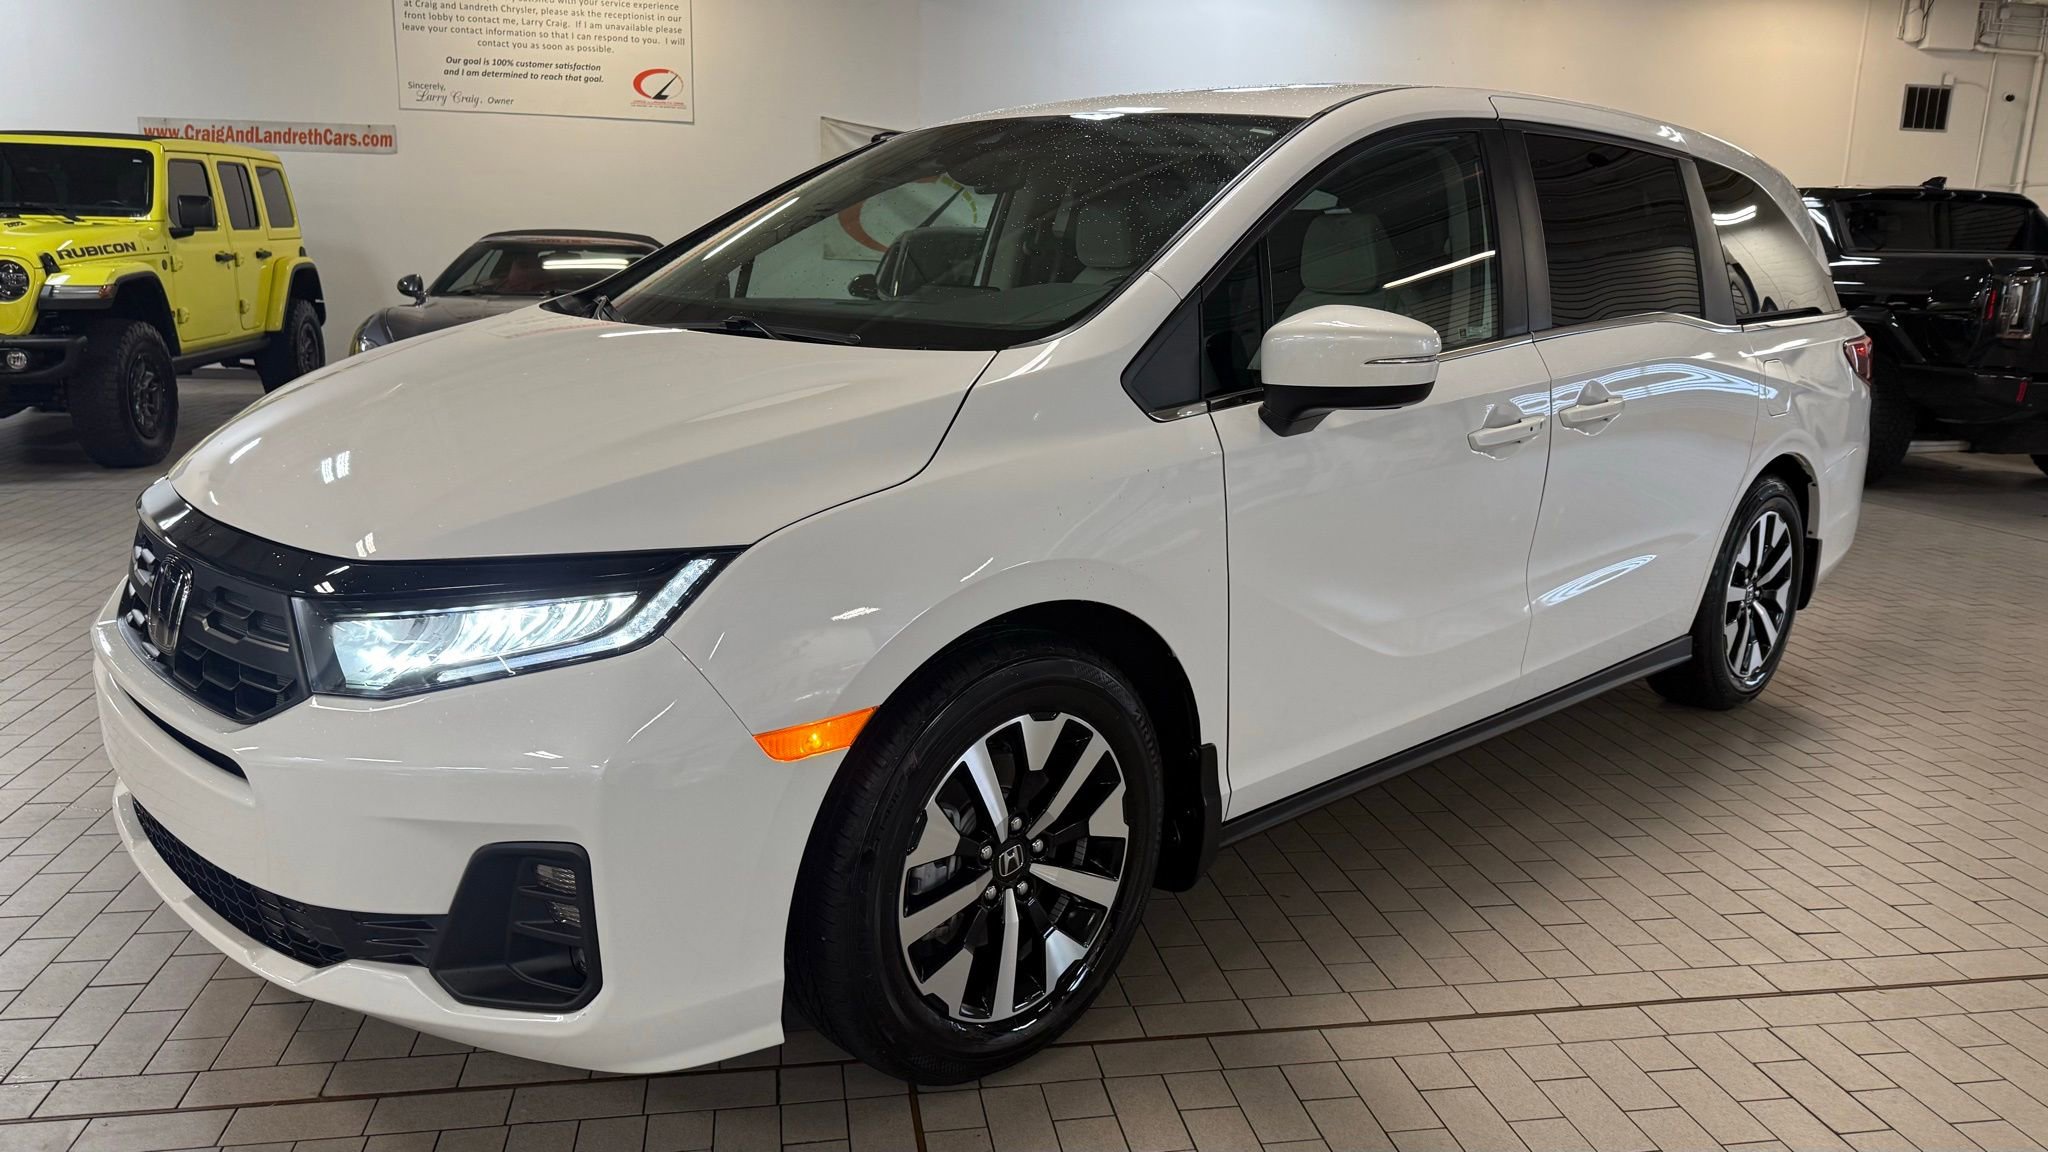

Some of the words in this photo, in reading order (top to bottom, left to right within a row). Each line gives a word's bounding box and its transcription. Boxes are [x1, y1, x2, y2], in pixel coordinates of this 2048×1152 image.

[415, 0, 438, 10] Craig
[440, 2, 457, 10] and
[459, 2, 498, 13] Landreth
[500, 4, 539, 15] Chrysler,
[541, 7, 568, 17] please
[588, 9, 602, 18] the
[604, 11, 655, 21] receptionist
[657, 13, 666, 21] in
[600, 0, 631, 8] service
[633, 2, 680, 11] experience
[404, 10, 426, 20] front
[428, 11, 453, 22] lobby
[456, 14, 465, 22] to
[467, 15, 500, 25] contact
[502, 18, 519, 26] me,
[521, 18, 543, 27] Larry
[545, 18, 570, 29] Craig.
[575, 21, 582, 29] If
[589, 22, 603, 30] am
[605, 22, 653, 33] unavailable
[655, 26, 683, 35] please
[402, 22, 426, 32] leave
[428, 25, 447, 34] your
[450, 26, 483, 35] contact
[485, 27, 537, 38] information
[539, 30, 549, 38] so
[551, 30, 569, 39] that
[576, 33, 592, 41] can
[594, 33, 628, 43] respond
[630, 35, 640, 43] to
[670, 37, 685, 46] will
[477, 40, 509, 48] contact
[511, 42, 529, 51] you
[541, 42, 563, 51] soon
[565, 44, 575, 52] as
[576, 43, 615, 54] possible.
[445, 56, 462, 65] Our
[463, 56, 482, 66] goal
[483, 57, 490, 65] is
[492, 58, 515, 67] 100%
[515, 60, 553, 69] customer
[555, 61, 601, 72] satisfaction
[443, 68, 460, 76] and
[481, 69, 529, 80] determined
[530, 72, 540, 80] to
[540, 73, 564, 82] reach
[564, 74, 583, 83] that
[583, 75, 605, 84] goal.
[407, 81, 447, 92] Sincerely,
[415, 90, 448, 107] Larry
[487, 96, 515, 105] Owner
[143, 123, 394, 148] www.CraigAndLandrethCars.com
[56, 242, 137, 260] RUBICON
